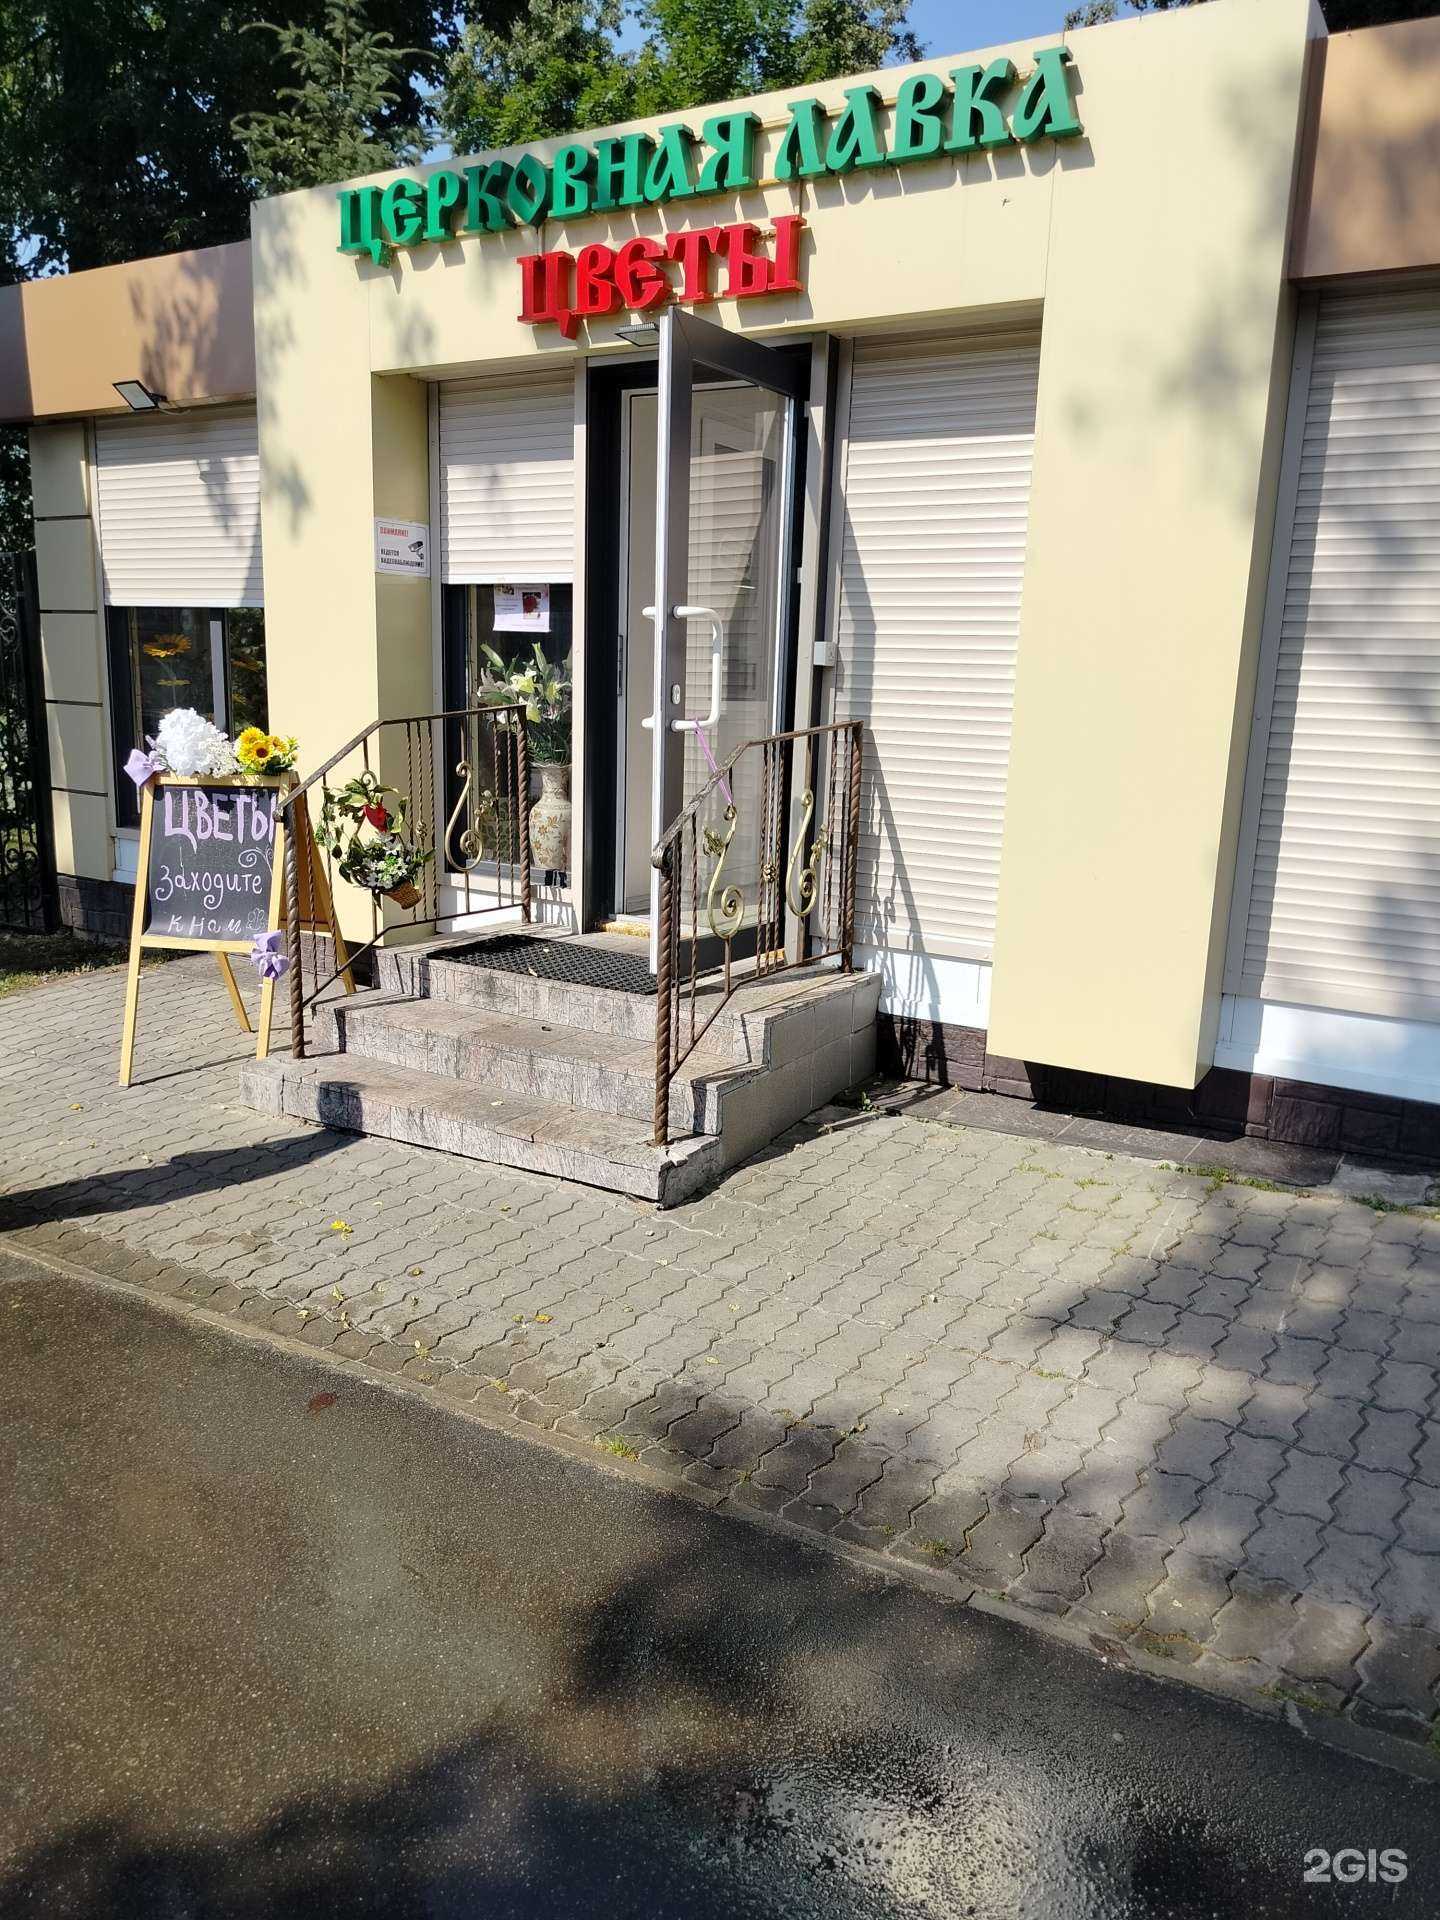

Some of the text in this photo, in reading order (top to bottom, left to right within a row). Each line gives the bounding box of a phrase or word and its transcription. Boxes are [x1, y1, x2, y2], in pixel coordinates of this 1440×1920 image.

[336, 46, 1084, 267] ЦЕРКОВНАЯ ЛАВКА
[517, 214, 806, 340] ЦВЕТЫ
[164, 790, 278, 854] ЦВЕТЫ
[155, 865, 263, 910] Заходите
